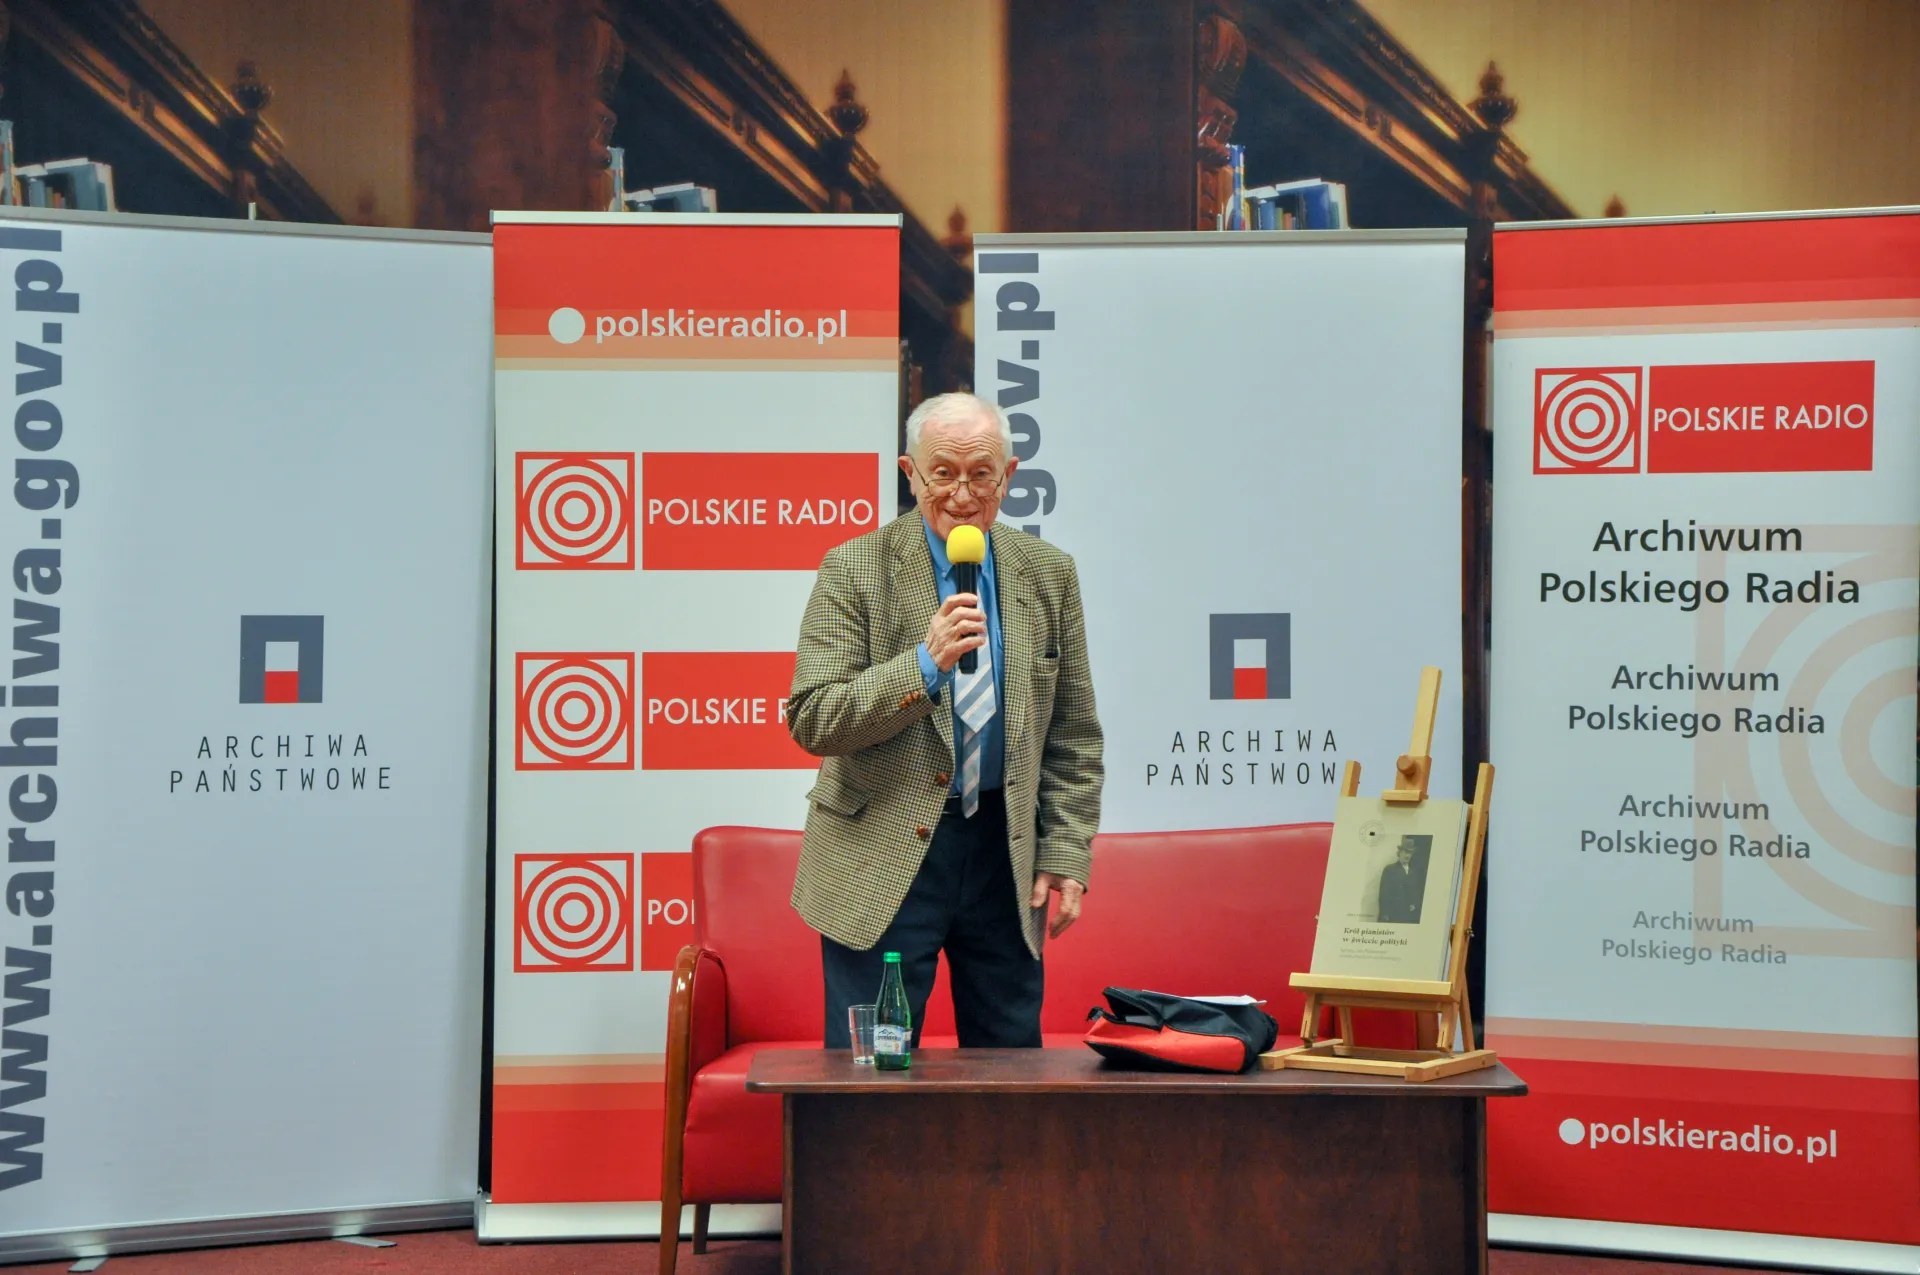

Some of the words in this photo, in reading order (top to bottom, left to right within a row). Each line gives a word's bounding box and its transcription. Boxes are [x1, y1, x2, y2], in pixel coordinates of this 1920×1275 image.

[595, 309, 847, 345] polskieradio.pl
[1653, 405, 1765, 432] POLSKIE
[1775, 403, 1869, 430] RADIO
[648, 498, 767, 526] POLSKIE
[778, 498, 875, 526] RADIO
[1592, 520, 1803, 552] Archiwum
[1539, 570, 1730, 612] Polskiego
[1746, 570, 1860, 604] Radia
[1611, 663, 1780, 692] Archiwum
[0, 227, 79, 1190] www.archiwa.gov.pl
[648, 697, 767, 725] POLSKIE
[1568, 703, 1722, 739] Polskiego
[1734, 706, 1826, 735] Radia
[197, 733, 368, 760] ARCHIWA
[1171, 729, 1337, 753] ARCHIWA
[170, 763, 391, 794] PAŃSTWOWE
[1146, 757, 1337, 786] PAŃSTWOW
[1618, 794, 1770, 821] Archiwum
[1580, 829, 1718, 862] Polskiego
[1729, 834, 1811, 860] Radia
[1632, 910, 1754, 933] Archiwum
[1602, 938, 1713, 966] Polskiego
[1722, 943, 1788, 965] Radia
[1589, 1117, 1838, 1164] polskieradio.pl
